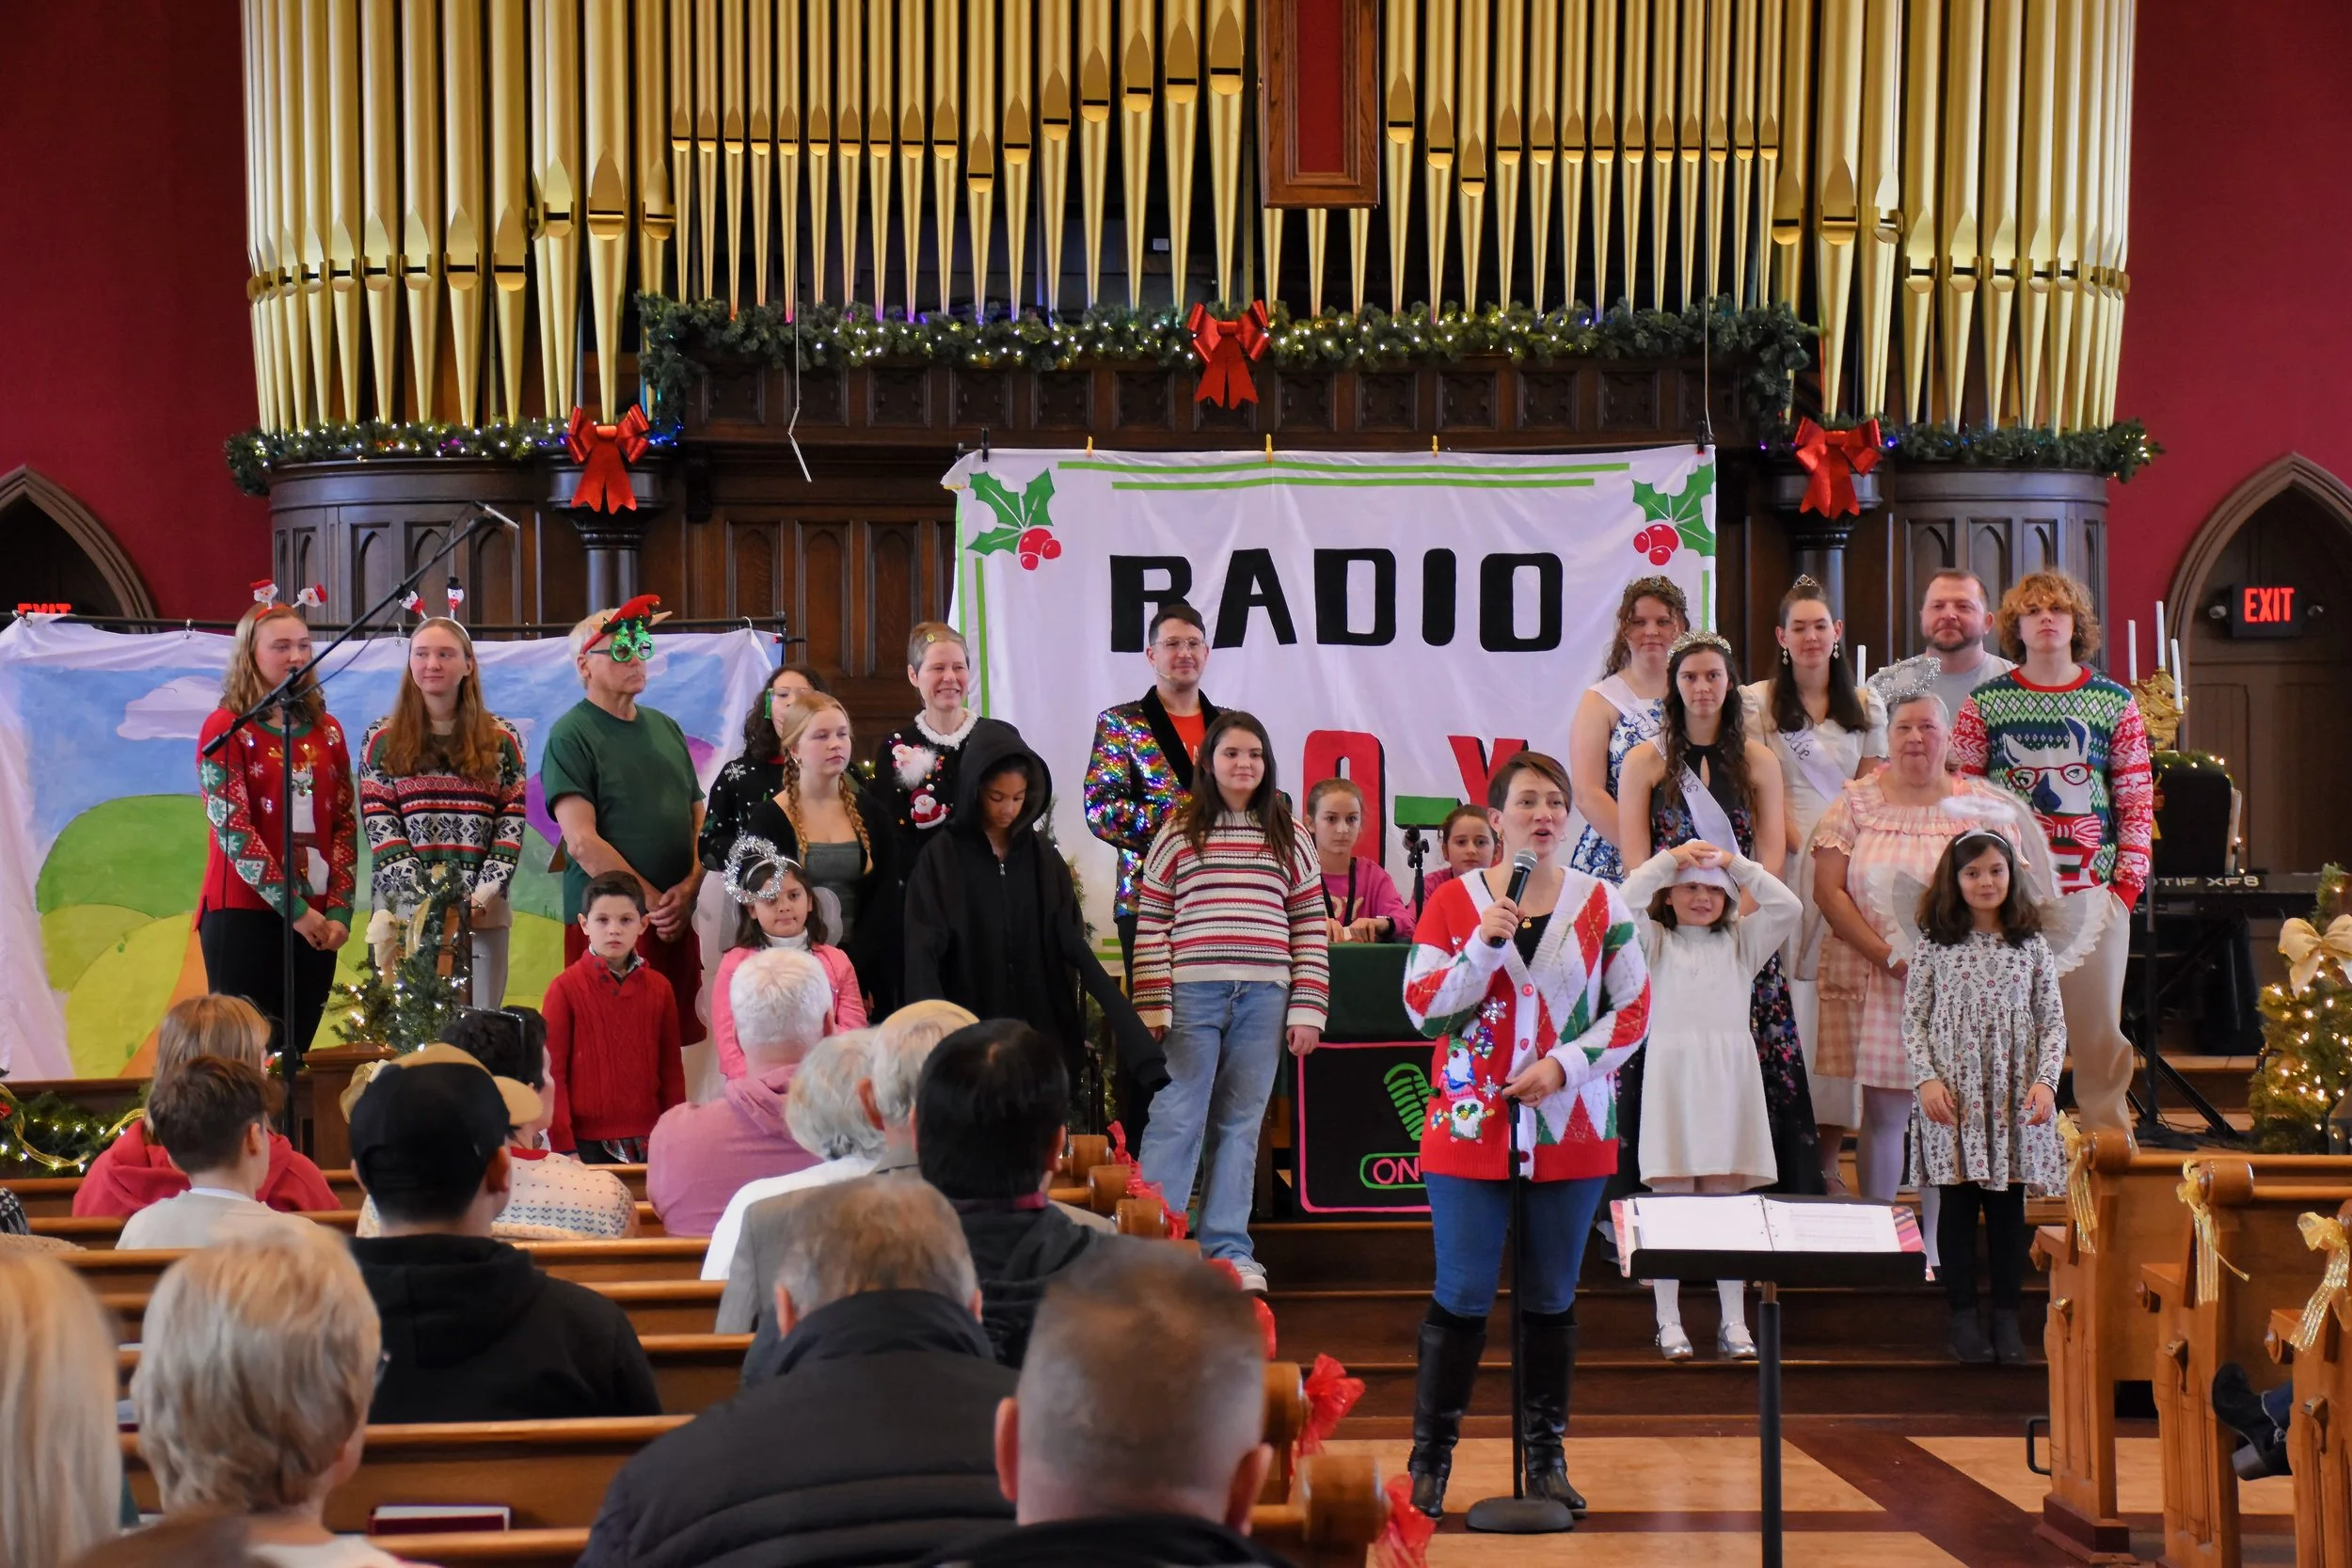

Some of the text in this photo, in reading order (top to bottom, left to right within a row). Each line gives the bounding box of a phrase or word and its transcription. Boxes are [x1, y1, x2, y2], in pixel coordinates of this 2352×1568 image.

[1109, 547, 1564, 653] RADIO
[2244, 587, 2295, 623] EXIT
[2205, 875, 2260, 887] XF8
[1373, 1156, 1420, 1185] ON
